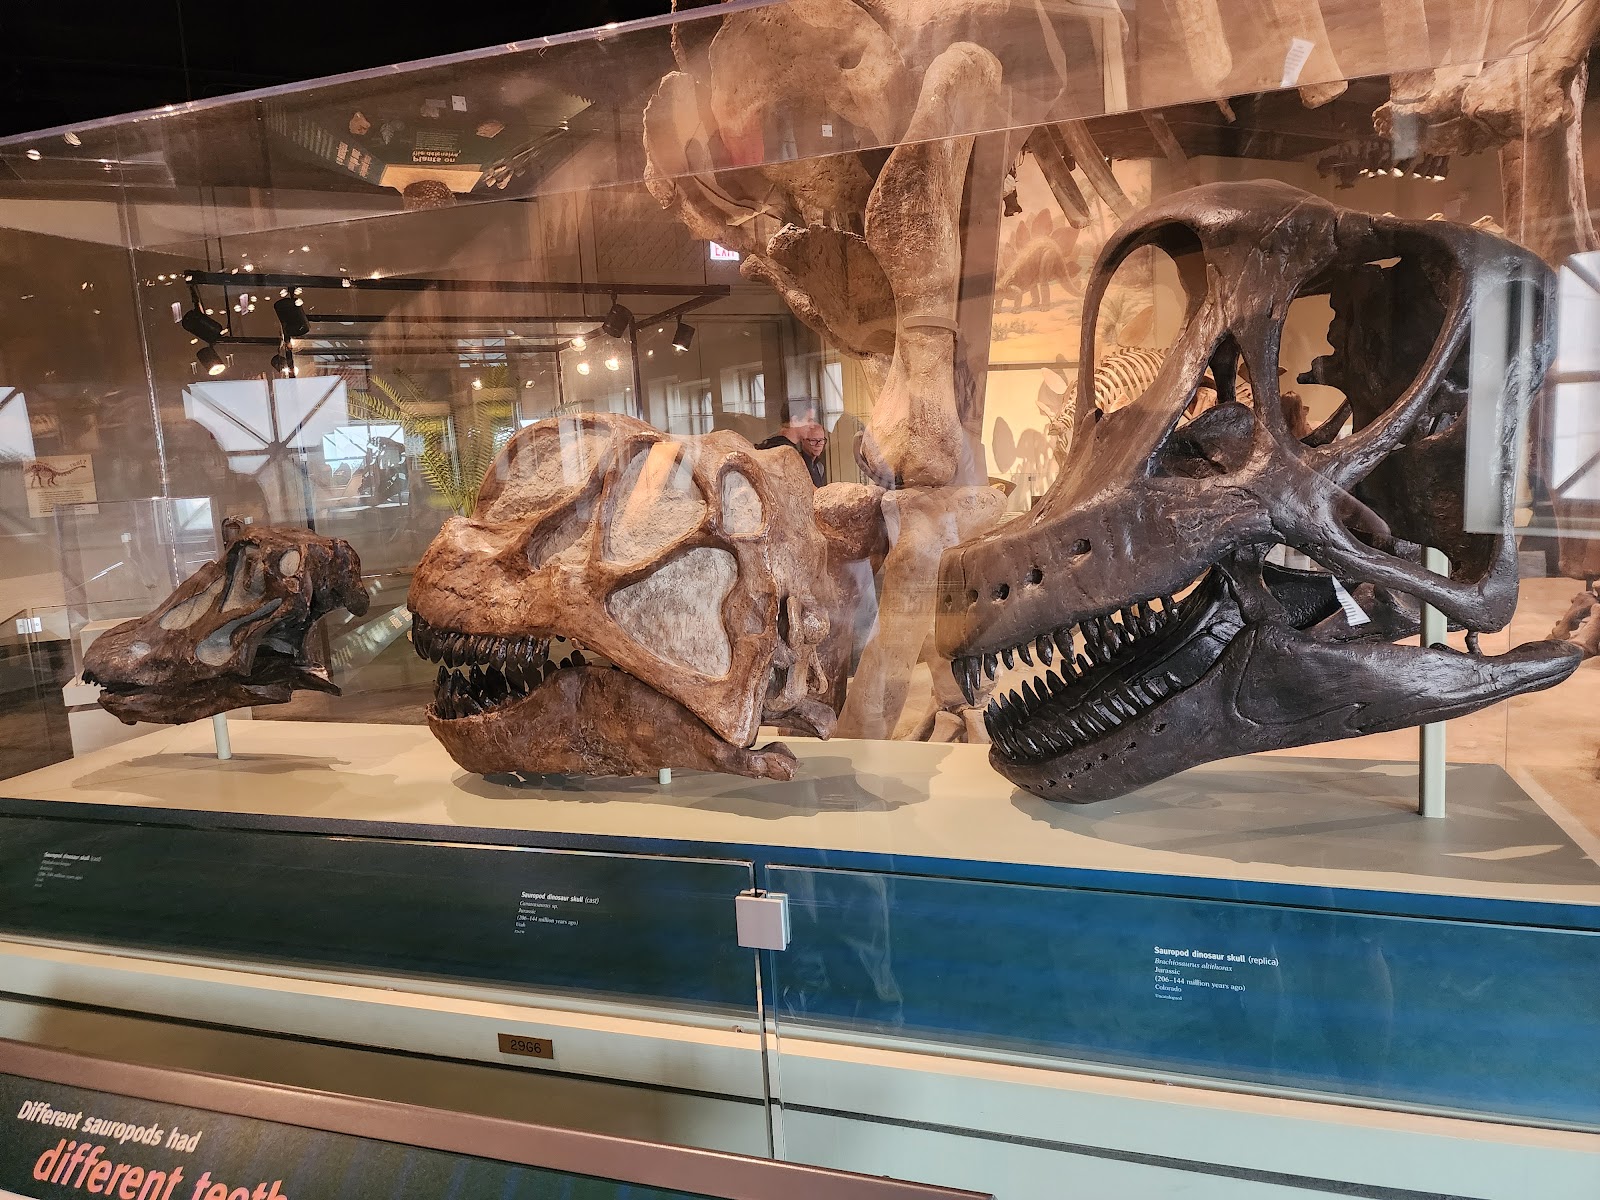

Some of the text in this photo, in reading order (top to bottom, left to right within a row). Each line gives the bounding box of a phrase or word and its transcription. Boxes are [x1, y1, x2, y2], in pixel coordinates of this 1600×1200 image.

[521, 891, 600, 905] Sauropod dinosaur skull (cast)
[1153, 946, 1280, 967] Sauropod dinosaur skull (replica)
[1154, 957, 1200, 969] Brachiosaurus
[1154, 966, 1181, 975] Jurassic
[1154, 984, 1182, 993] Colorado
[1186, 979, 1210, 987] million
[1211, 982, 1230, 990] years
[1230, 984, 1246, 992] ago)
[510, 1039, 542, 1054] 29G6
[17, 1100, 202, 1153] Different sauropods had
[33, 1138, 184, 1200] different
